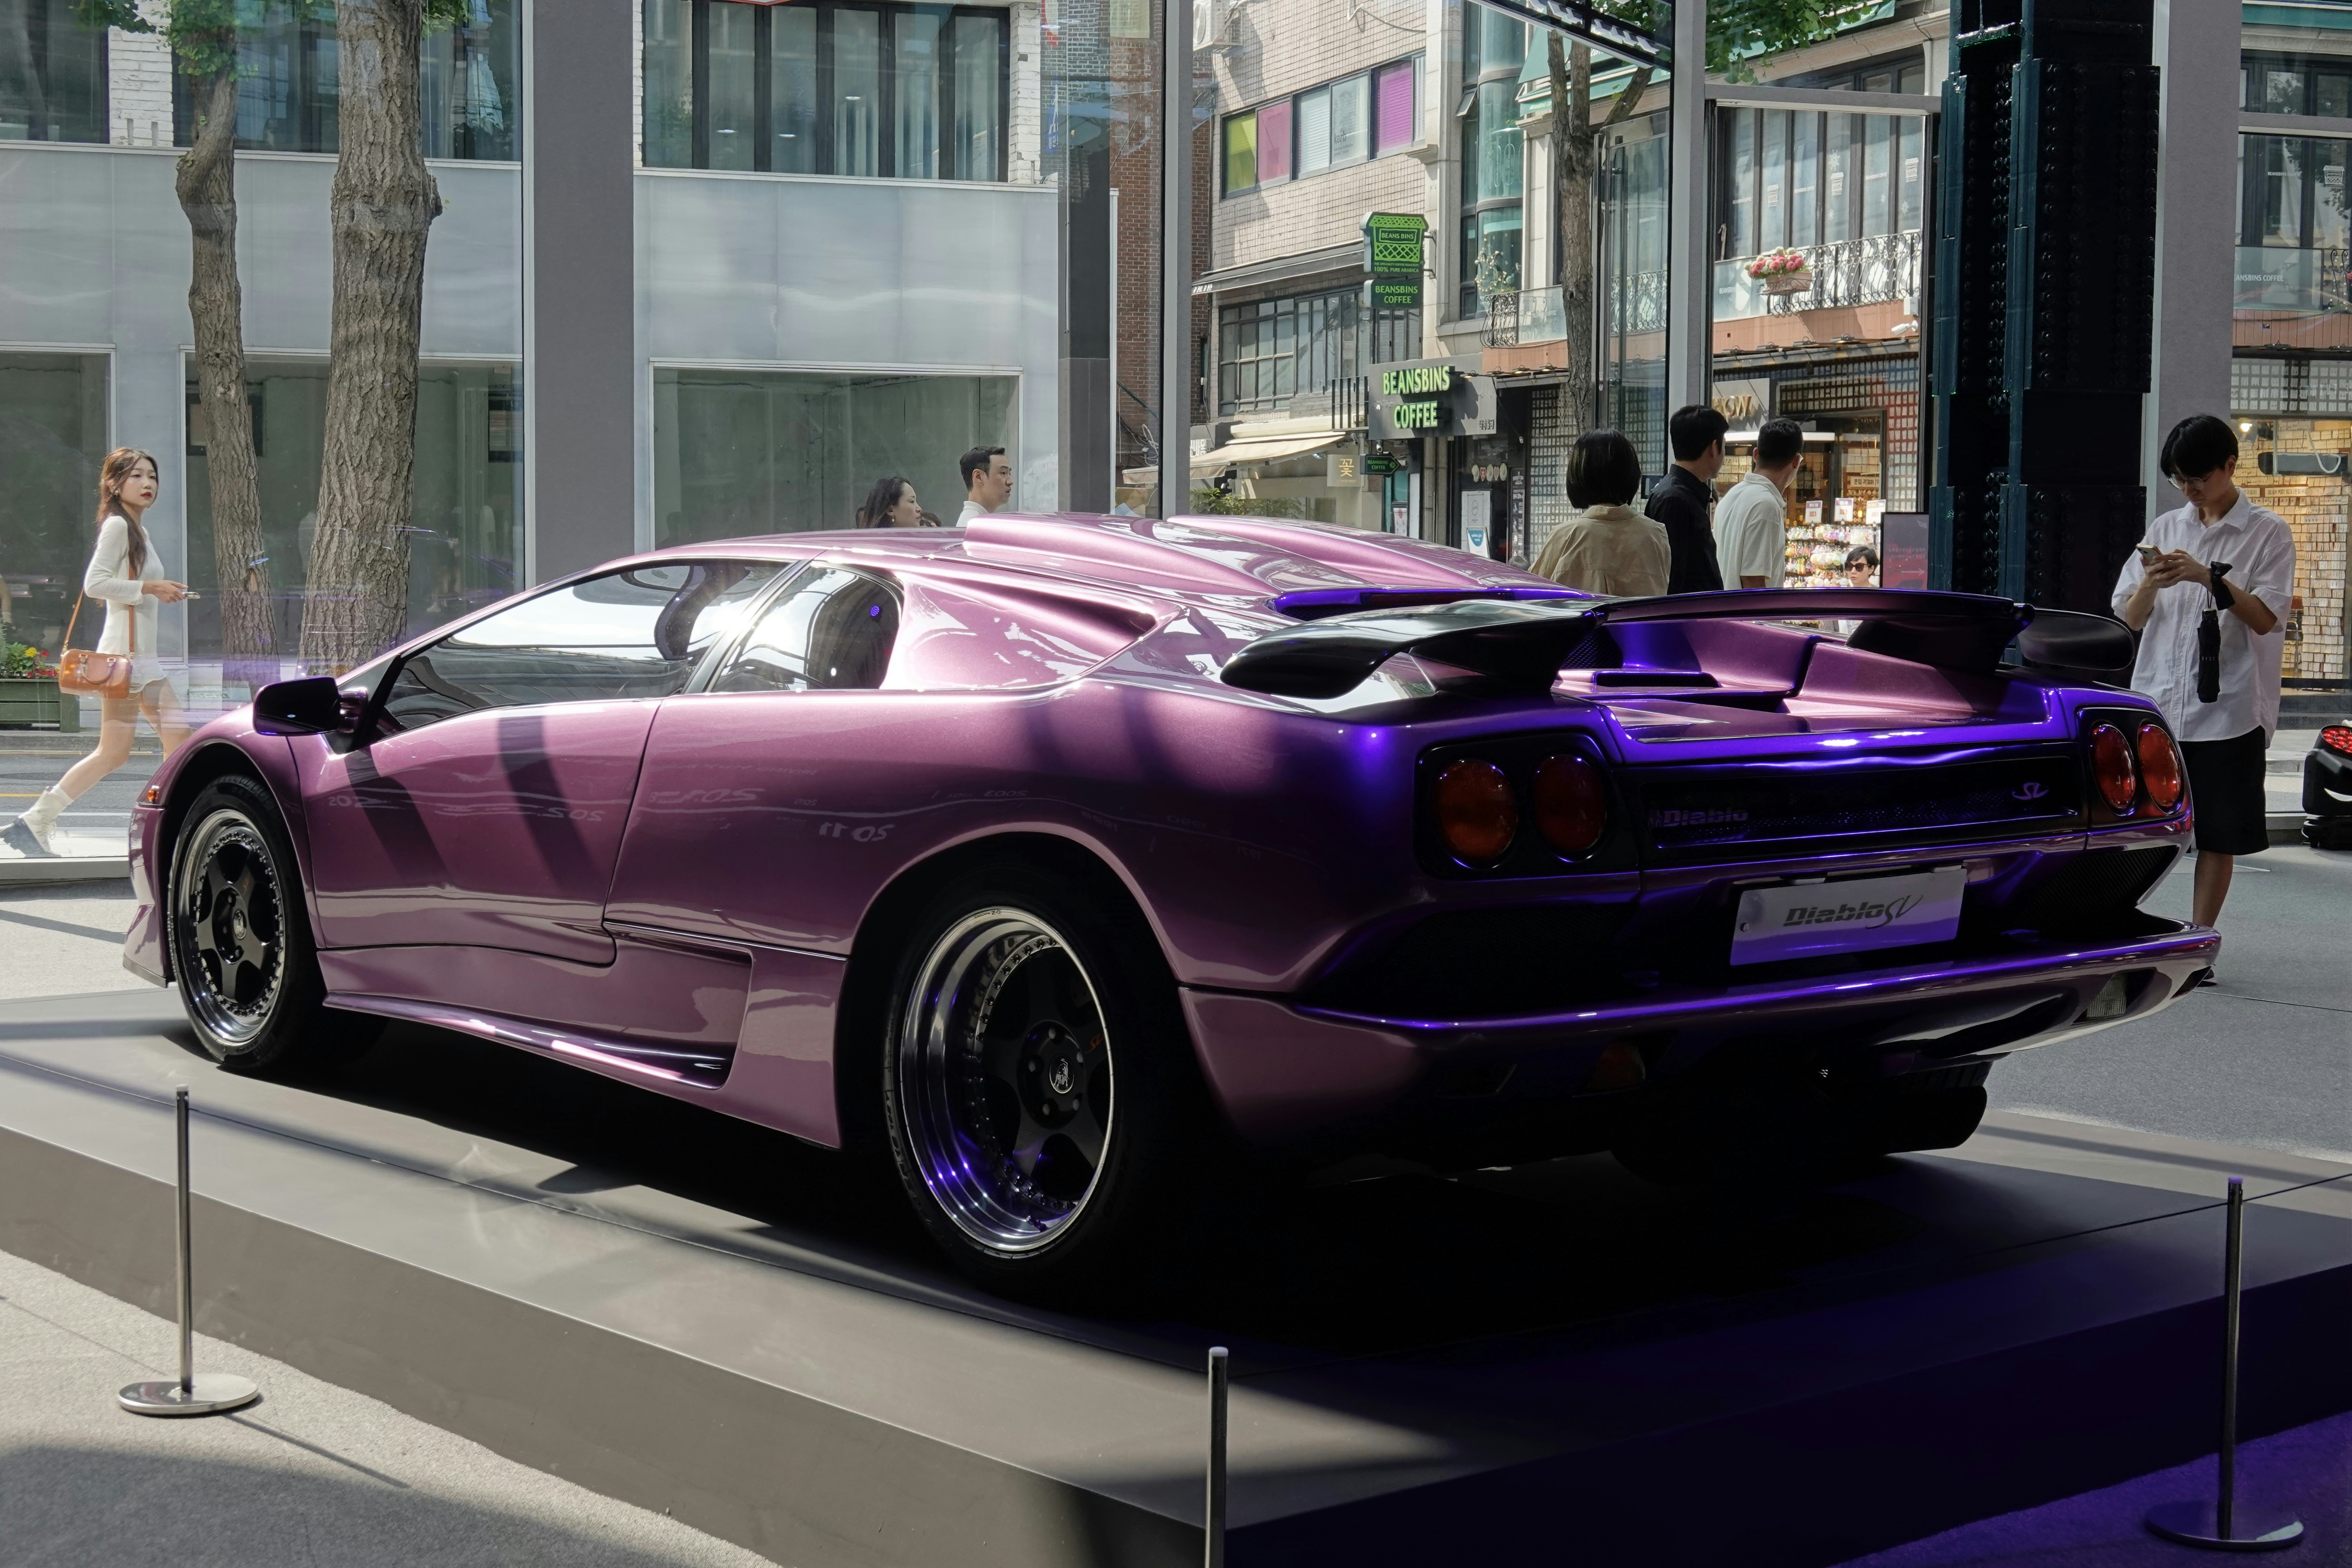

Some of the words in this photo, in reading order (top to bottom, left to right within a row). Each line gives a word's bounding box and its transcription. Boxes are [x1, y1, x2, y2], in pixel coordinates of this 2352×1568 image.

[1334, 131, 1346, 144] kerb
[1375, 285, 1418, 294] BEANSBINS
[1383, 366, 1450, 395] BEANSBINS
[1394, 401, 1438, 429] COFFEE
[1338, 459, 1354, 477] 꽃
[1663, 807, 1748, 827] Diablo
[1783, 902, 1885, 927] Diablo
